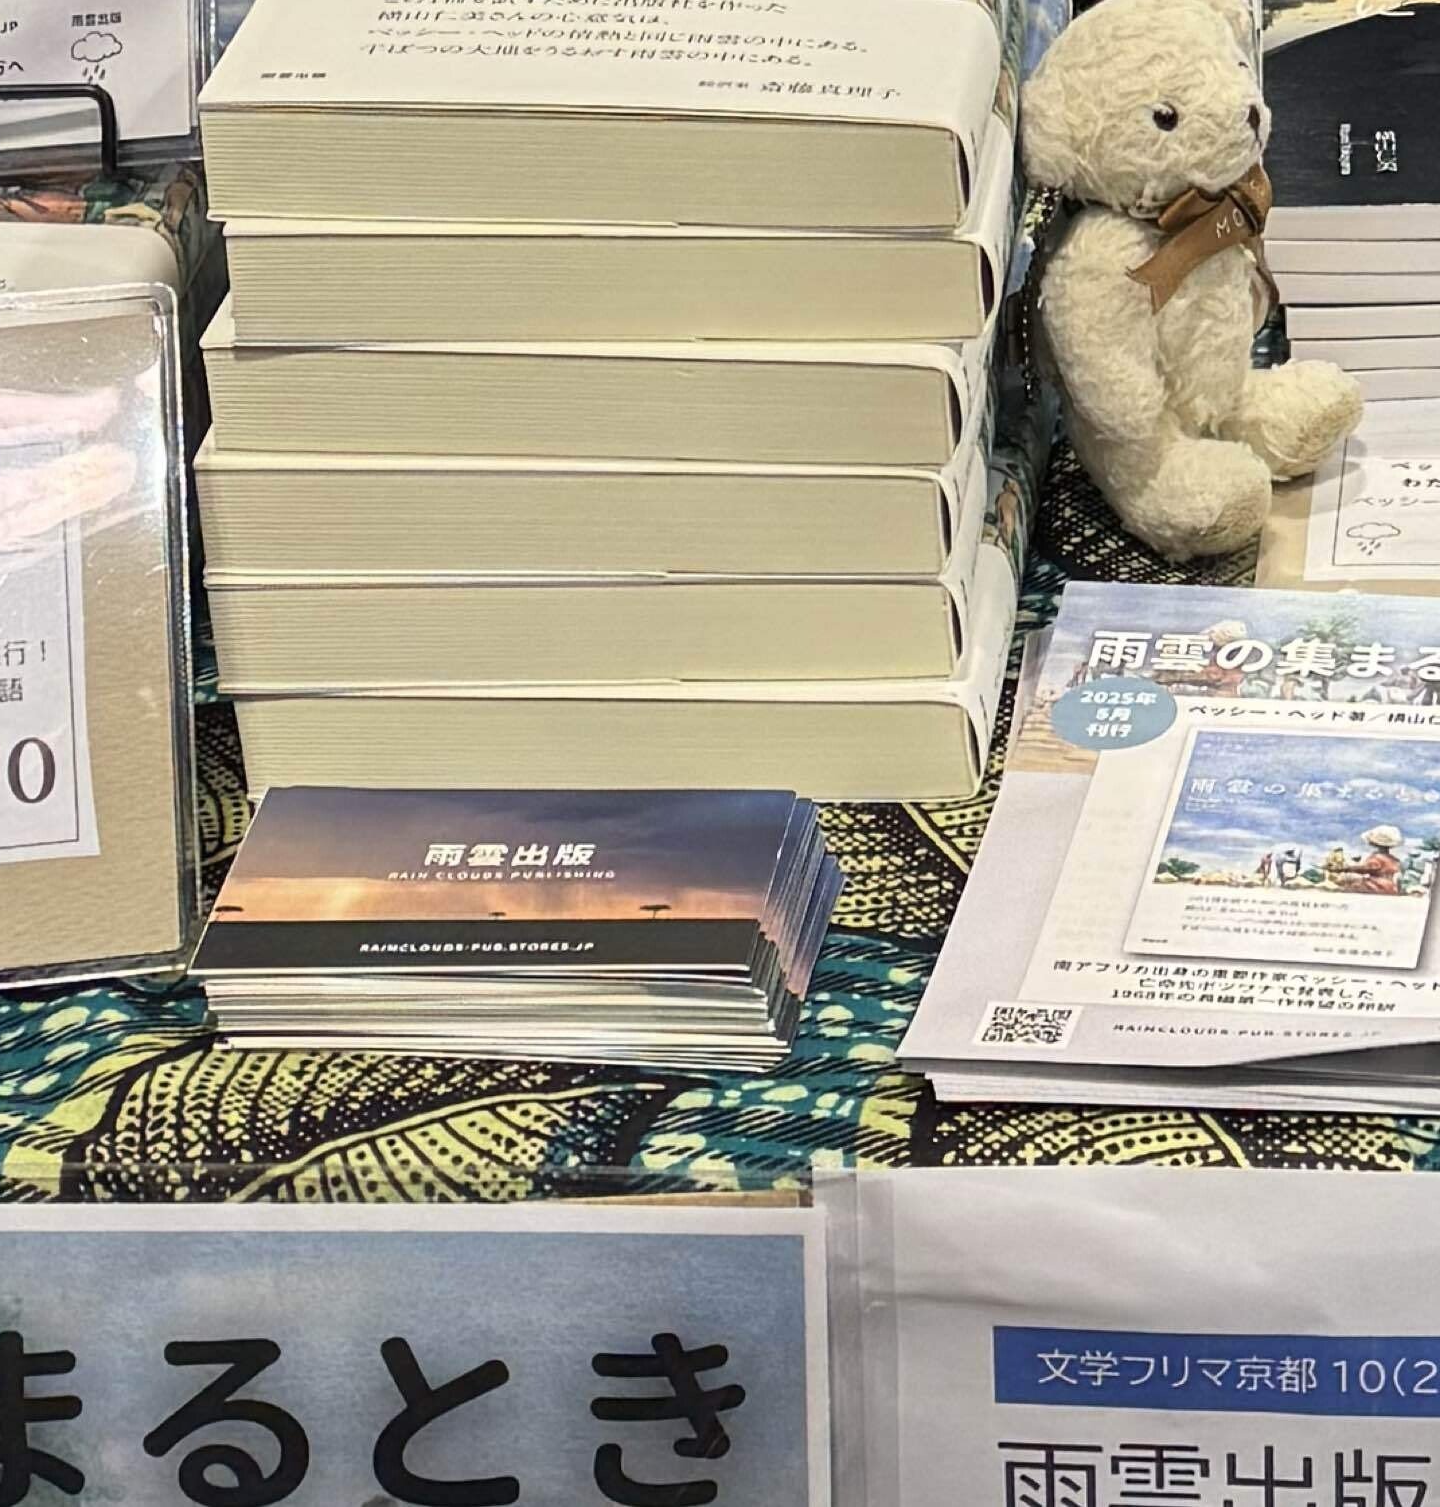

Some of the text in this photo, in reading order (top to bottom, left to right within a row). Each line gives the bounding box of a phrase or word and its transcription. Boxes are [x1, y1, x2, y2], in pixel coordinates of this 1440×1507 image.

[1080, 690, 1157, 705] 2025年
[424, 843, 597, 868] 雨雲出版
[1035, 1346, 1319, 1398] 文学フリマ京都
